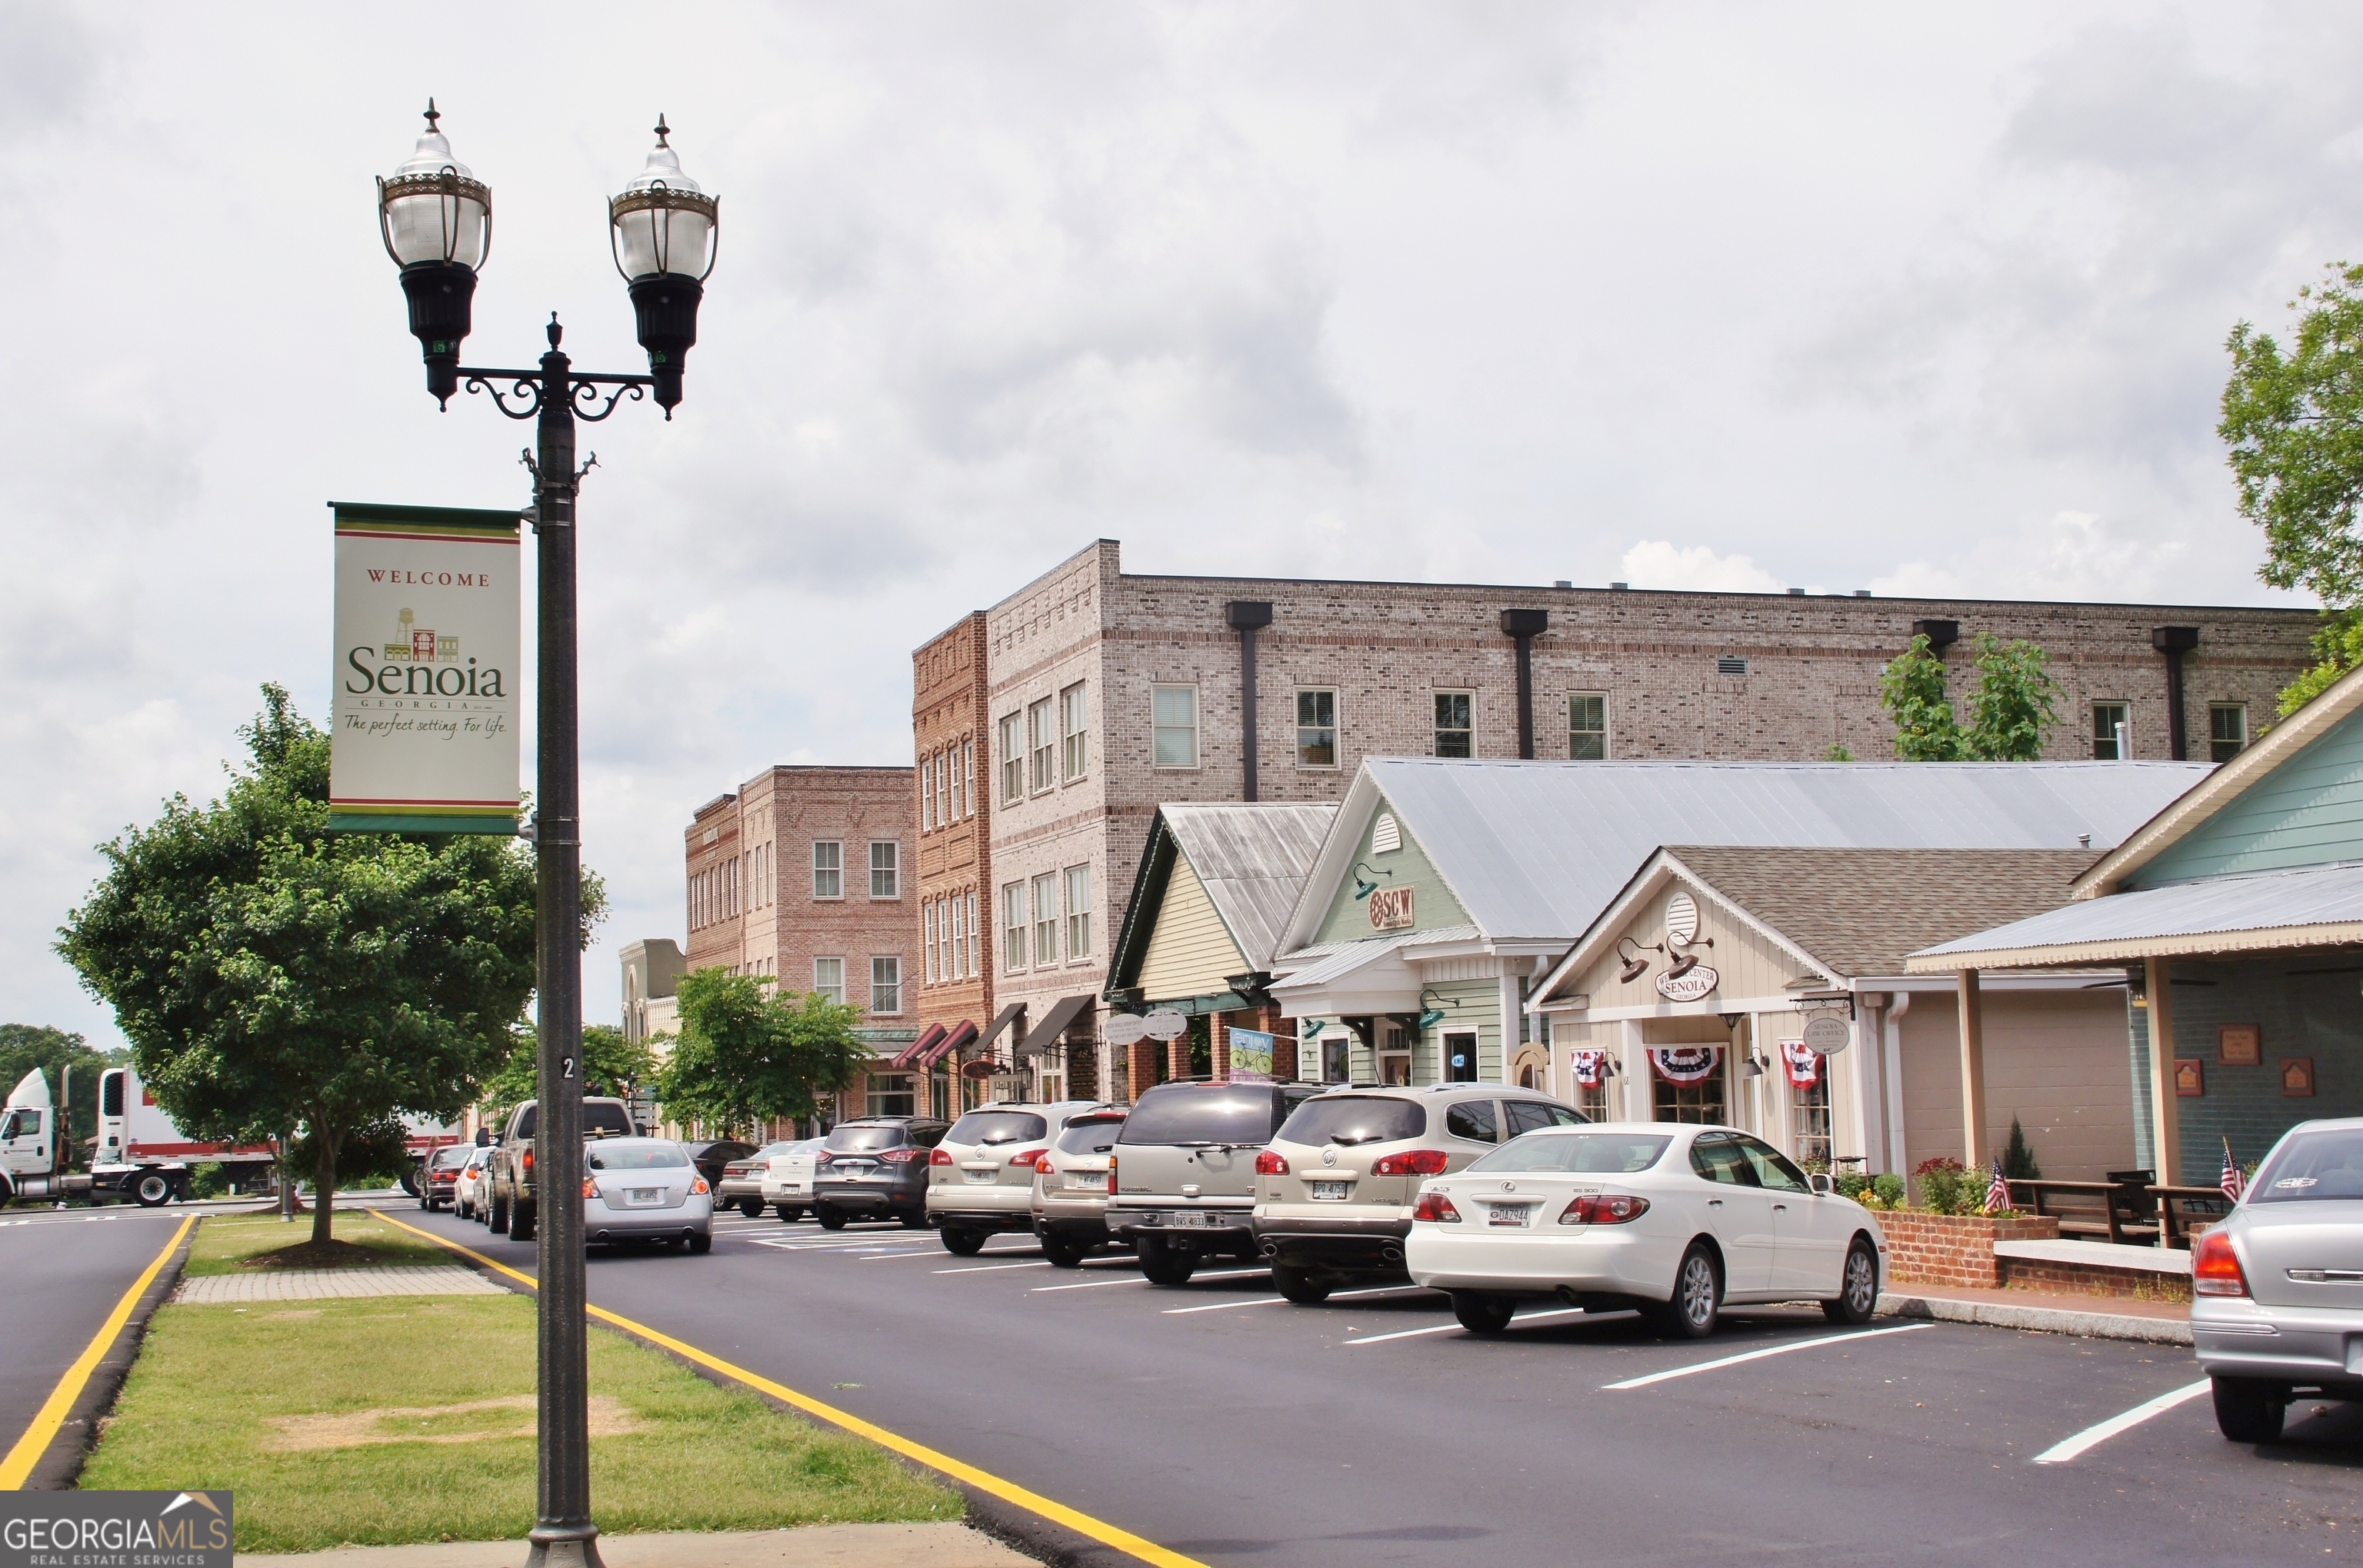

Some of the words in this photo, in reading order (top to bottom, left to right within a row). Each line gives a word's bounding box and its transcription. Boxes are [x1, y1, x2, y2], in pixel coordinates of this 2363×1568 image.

[367, 569, 489, 587] WELCOME
[346, 646, 507, 697] Senoia
[345, 714, 367, 730] The
[368, 713, 415, 737] perfect
[417, 719, 458, 741] setting.
[464, 717, 482, 731] For
[485, 715, 507, 739] life.
[1384, 889, 1410, 917] SCW
[1690, 969, 1714, 982] CENTER
[1665, 980, 1707, 994] SENOIA
[564, 1058, 574, 1078] 2
[1500, 1210, 1528, 1221] DAZ944
